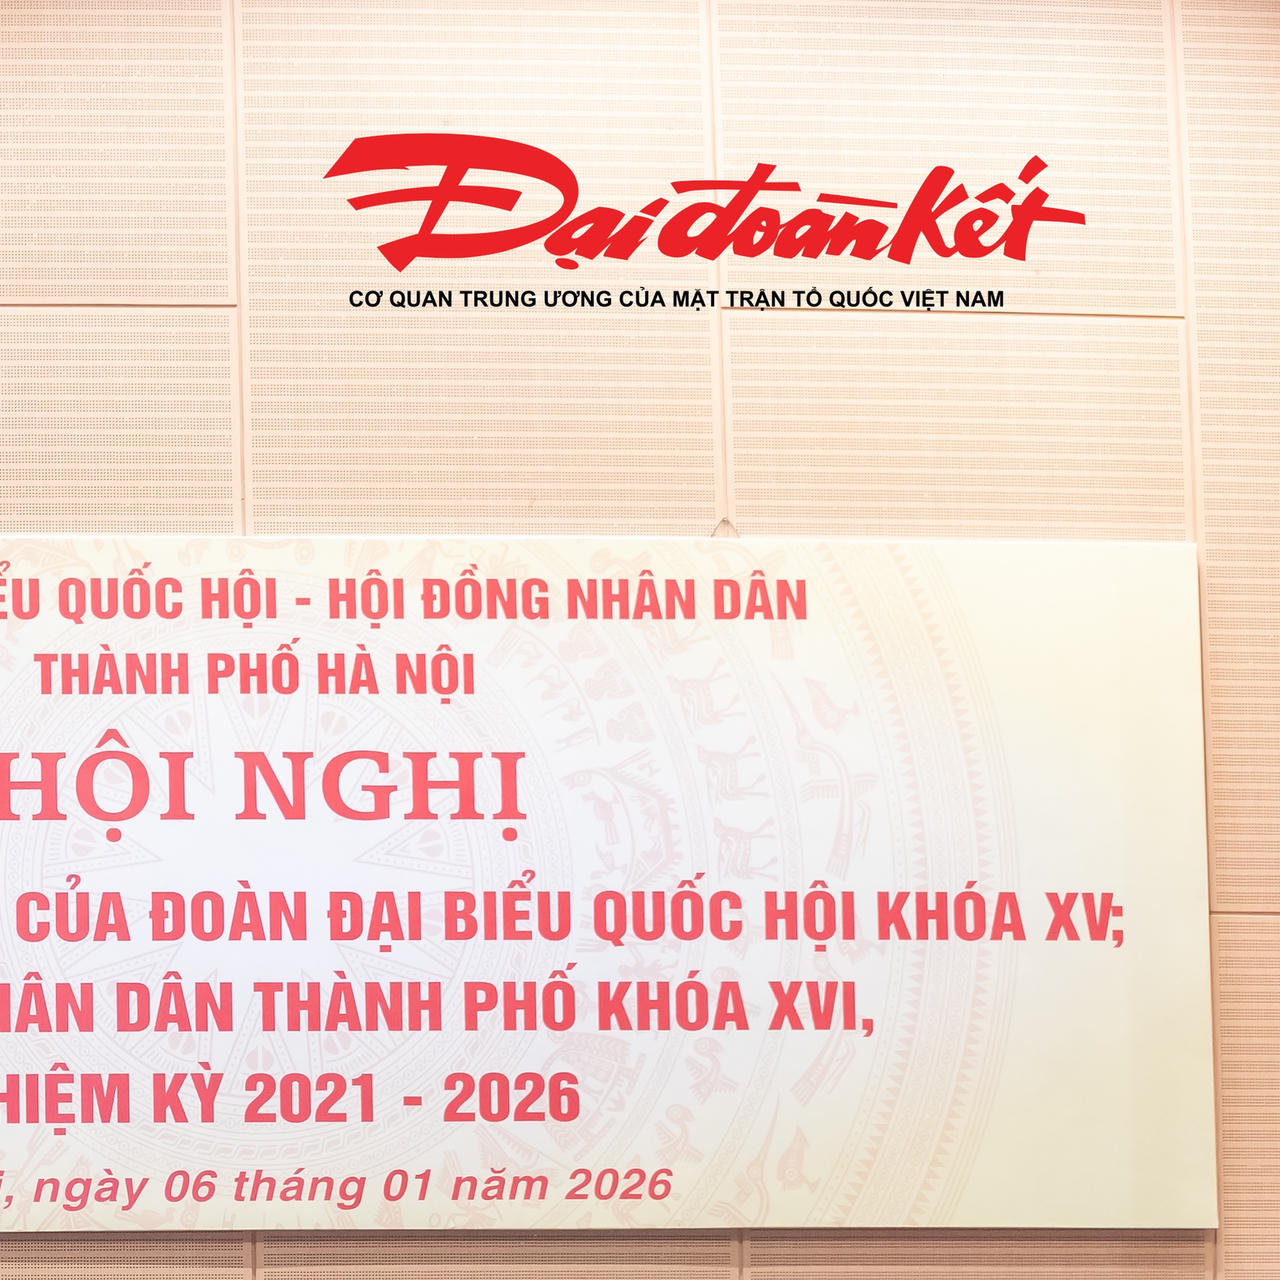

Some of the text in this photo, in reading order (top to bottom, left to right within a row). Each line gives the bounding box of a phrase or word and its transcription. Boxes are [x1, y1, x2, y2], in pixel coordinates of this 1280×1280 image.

[59, 563, 182, 624] QUỐC
[201, 569, 276, 628] HỘI
[329, 569, 404, 628] HỘI
[422, 564, 549, 620] ĐỒNG
[568, 570, 695, 619] NHÂN
[714, 570, 806, 619] DÂN
[34, 644, 474, 704] THÀNH PHỐ HÀ NỘI
[235, 751, 526, 841] NGHỊ
[16, 875, 130, 942] CỦA
[150, 881, 306, 941] ĐOÀN
[328, 892, 421, 952] ĐẠI
[444, 870, 570, 940] BIỂU
[594, 873, 742, 946] QUỐC
[765, 880, 854, 951] HỘI
[878, 881, 1026, 941] KHÓA
[1046, 893, 1123, 947] XV;
[117, 971, 232, 1032] DÂN
[254, 971, 441, 1031] THÀNH
[464, 963, 575, 1031] PHỐ
[598, 970, 748, 1031] KHÓA
[769, 982, 873, 1037] XVI,
[153, 1062, 223, 1122] KỲ
[245, 1073, 373, 1122] 2021
[444, 1072, 579, 1122] 2026
[34, 1169, 148, 1211] ngày
[165, 1171, 216, 1202] 06
[235, 1168, 365, 1210] tháng
[384, 1170, 430, 1201] 01
[452, 1168, 548, 1200] năm
[566, 1169, 672, 1200] 2026
